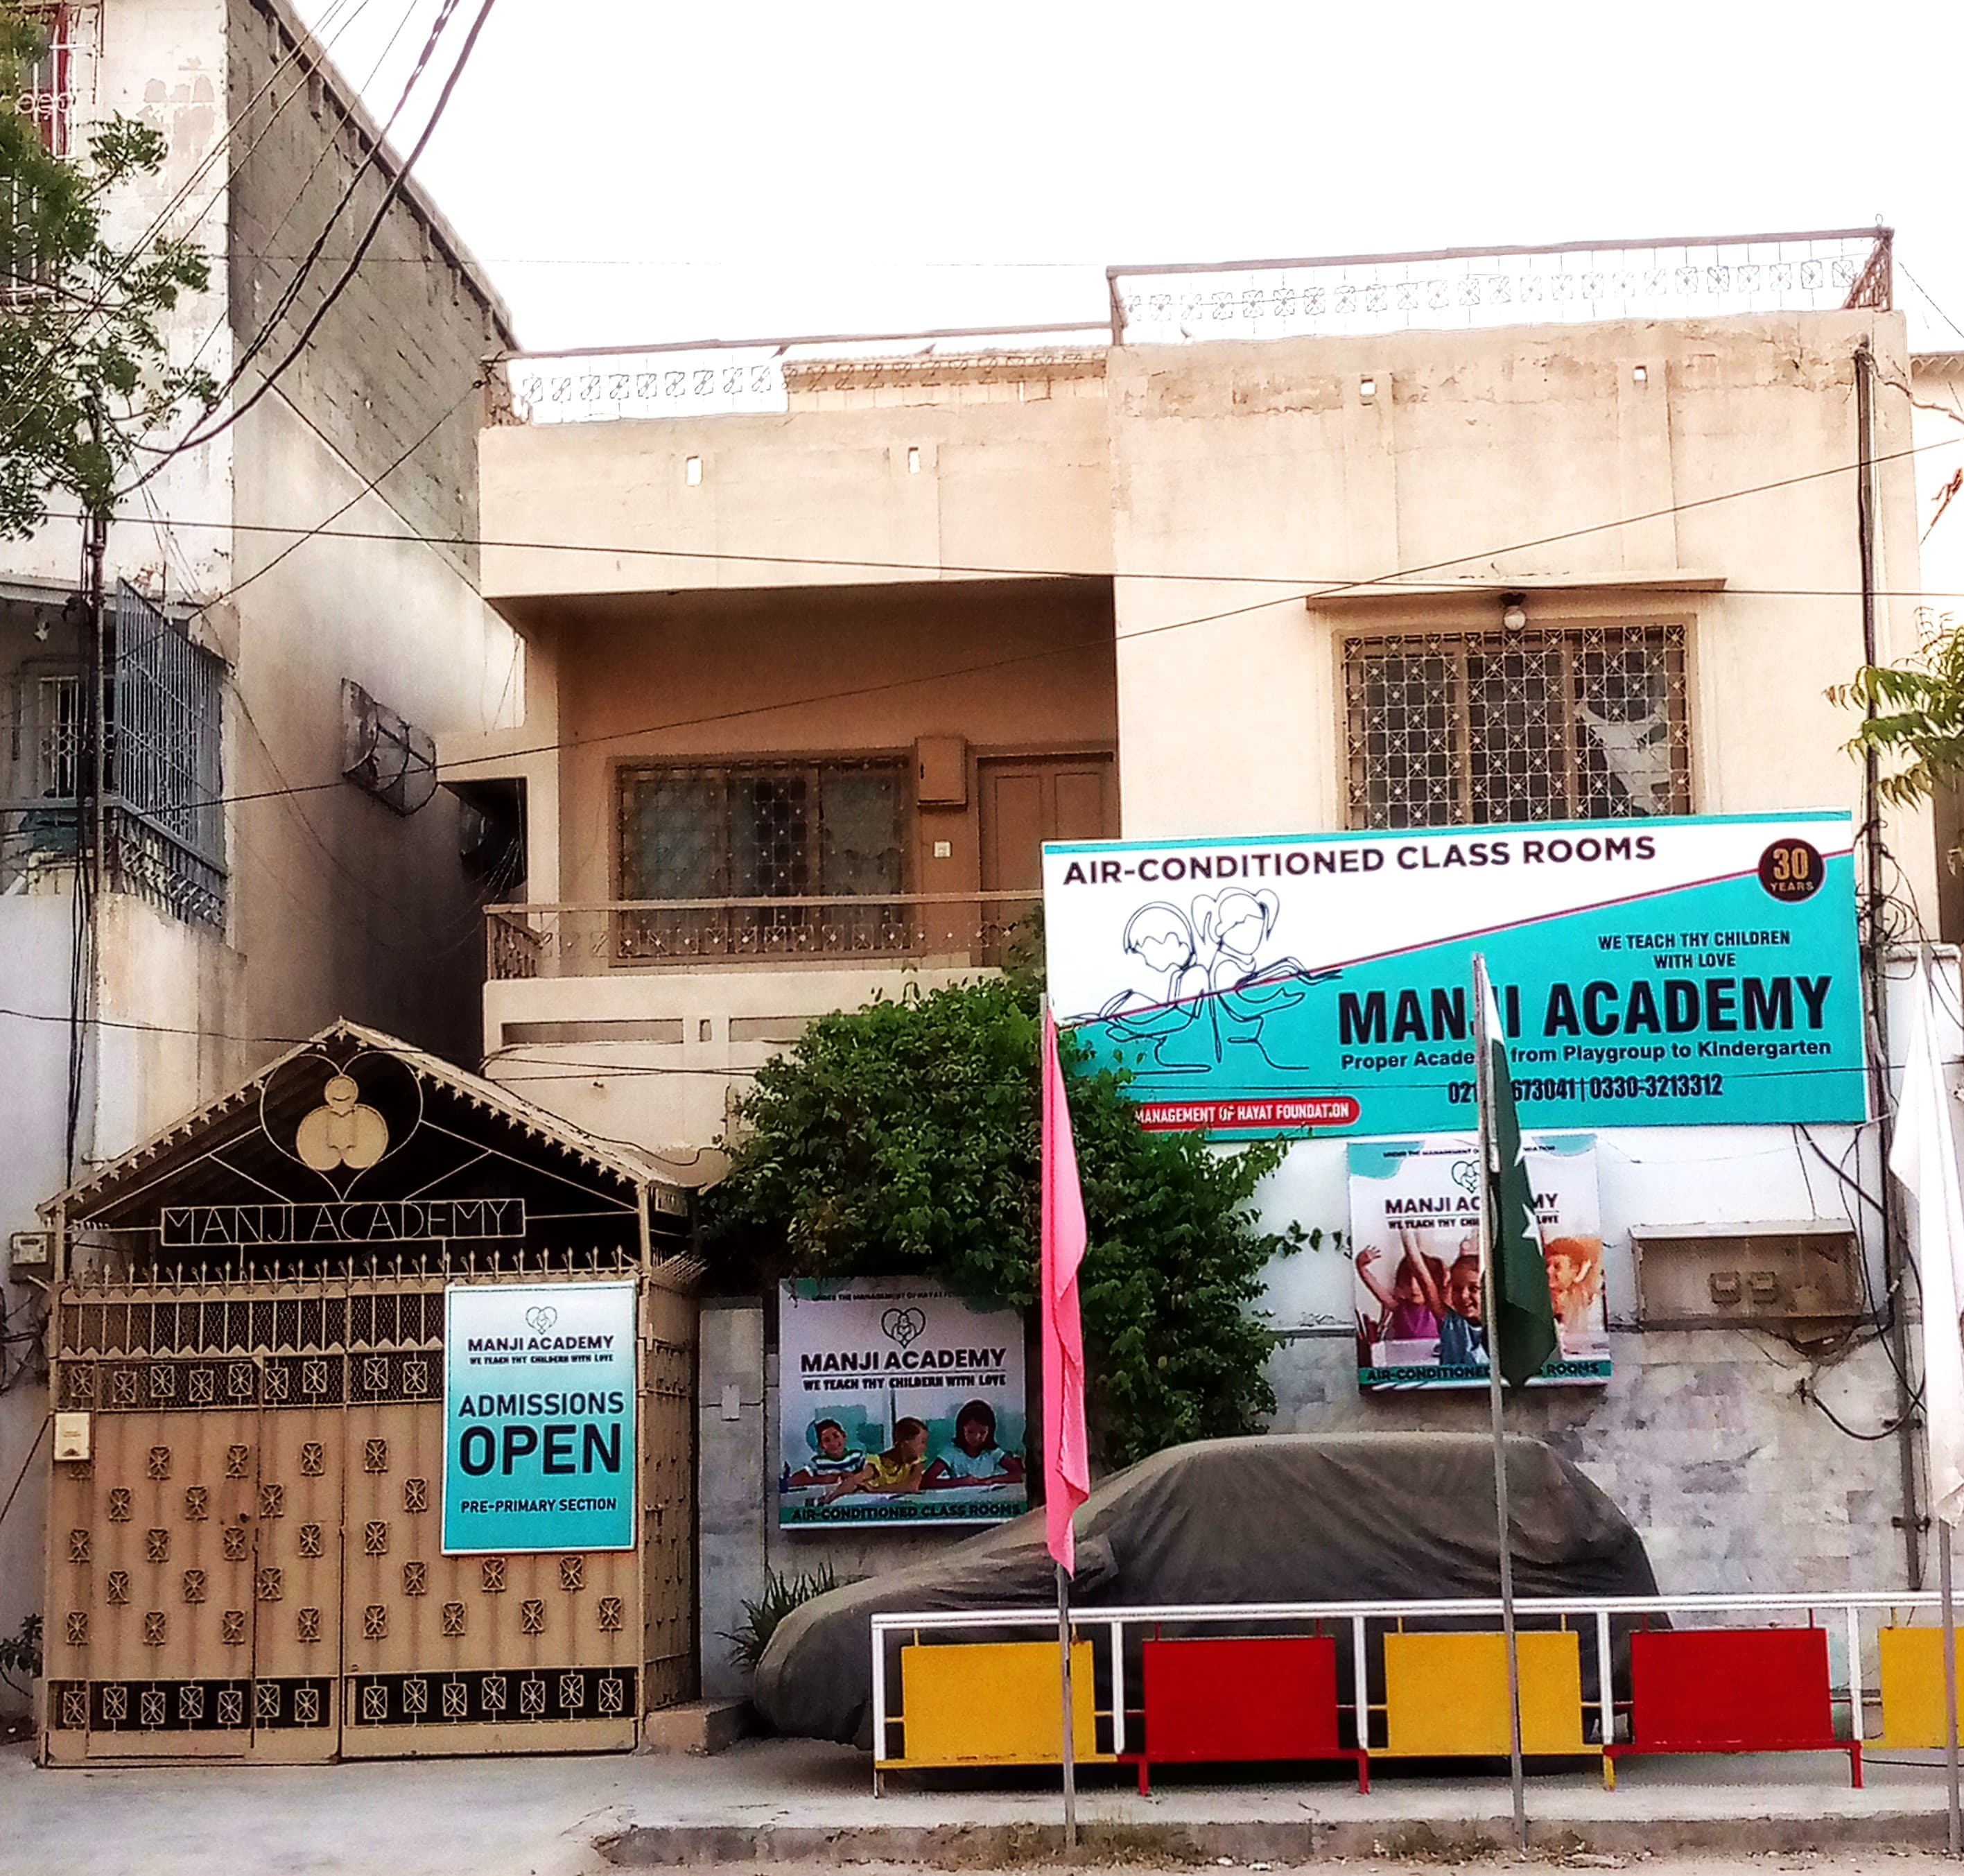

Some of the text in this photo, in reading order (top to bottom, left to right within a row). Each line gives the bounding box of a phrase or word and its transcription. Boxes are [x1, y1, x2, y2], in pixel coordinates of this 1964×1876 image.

[1062, 835, 1656, 885] AIR-CONDITIONED CLASS ROOMS
[1773, 848, 1809, 880] 30
[1770, 880, 1815, 893] YEARS
[1598, 930, 1791, 950] WE TEACH THY CHILDREN
[1653, 953, 1737, 969] WITH LOVE
[1338, 975, 1832, 1045] MANI ACADEMY
[1341, 1040, 1832, 1072] Proper Acade from Playgroup to Kindergarten
[1592, 1074, 1723, 1100] 0330-3213312
[1237, 1105, 1273, 1121] HAYAT
[1276, 1102, 1349, 1120] FOUNDATON
[1385, 1196, 1451, 1214] MANJI
[162, 1199, 510, 1244] MANJI ACADEMY
[1438, 1218, 1456, 1228] THY
[467, 1335, 614, 1352] MANJI ACADEMY
[469, 1357, 482, 1365] WE
[484, 1356, 510, 1365] TEACH
[594, 1353, 614, 1362] LOVE
[801, 1348, 1007, 1373] MANJI ACADEMY
[1546, 1363, 1599, 1375] ROOMS
[803, 1379, 821, 1391] WE
[823, 1378, 859, 1391] TEACH
[862, 1378, 885, 1389] THY
[946, 1375, 975, 1387] WITH
[979, 1374, 1007, 1386] LOVE
[458, 1391, 624, 1418] ADMISSIONS
[460, 1423, 621, 1476] OPEN
[460, 1497, 617, 1513] PRE-PRIMARY SECTION
[791, 1503, 1022, 1521] AIR-CONDITIONED CLASS ROOMS
